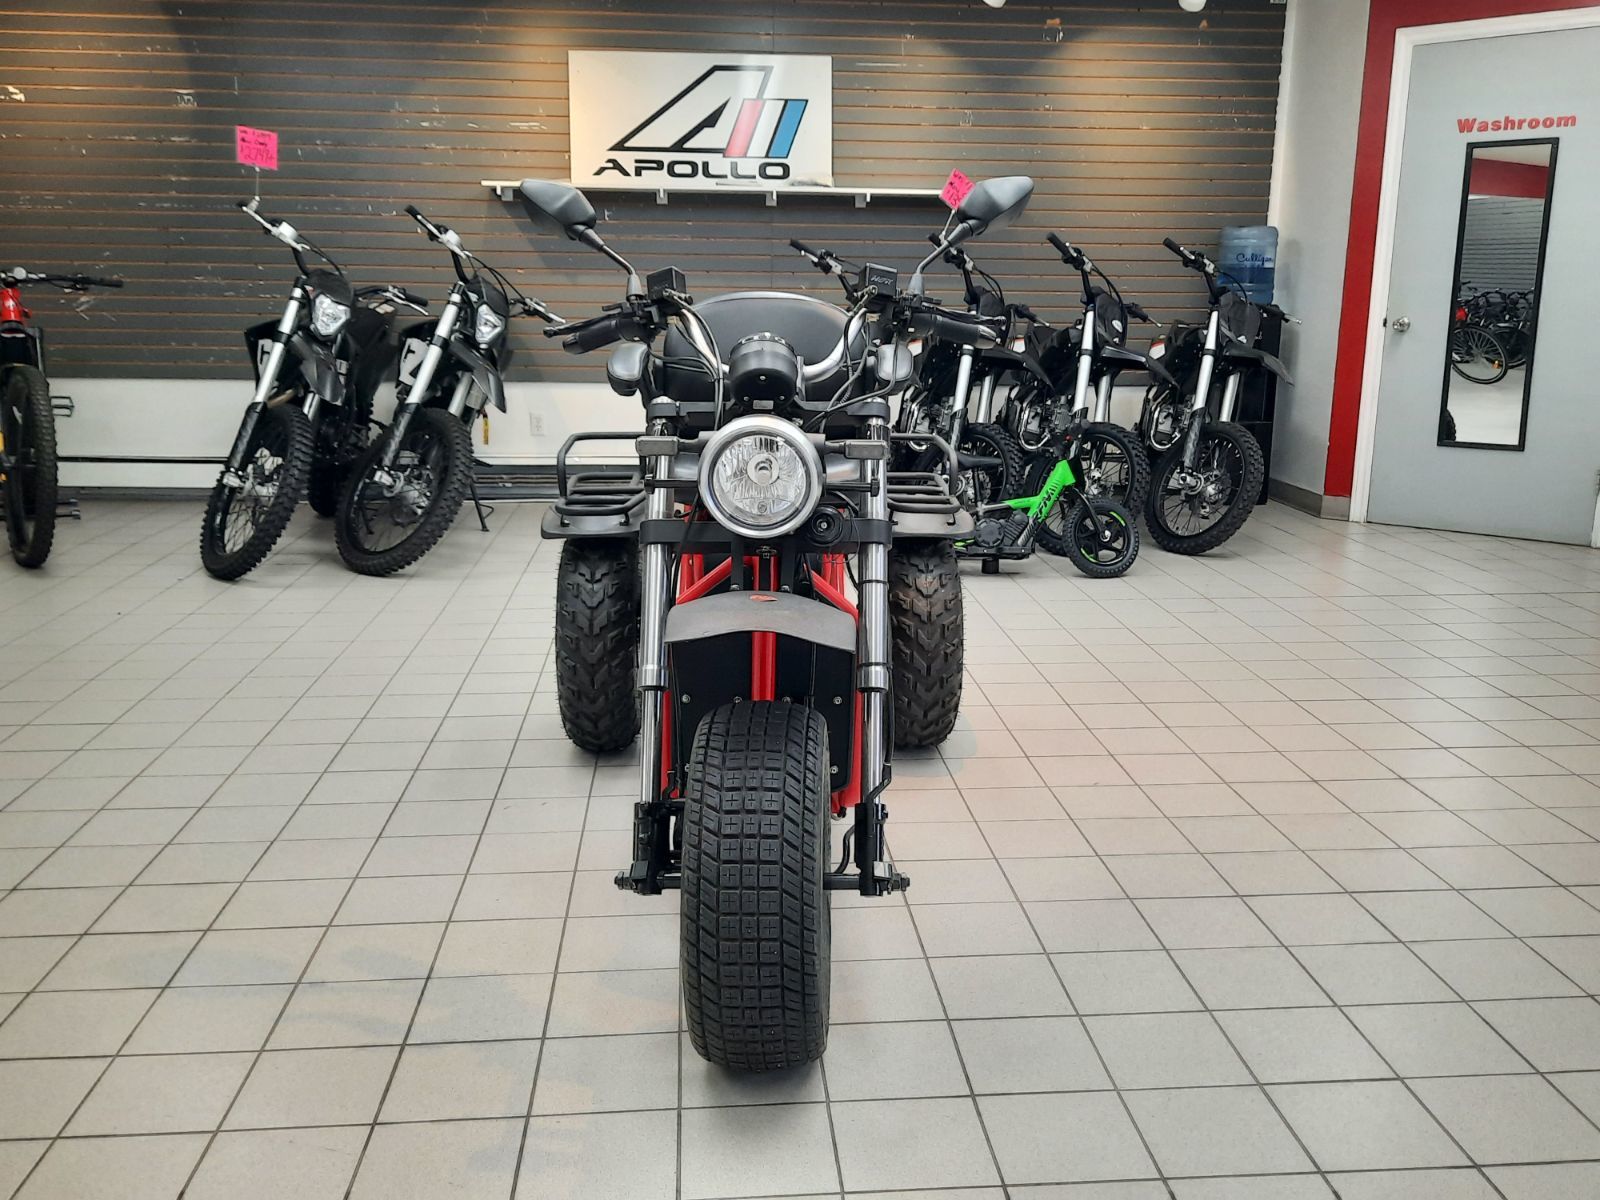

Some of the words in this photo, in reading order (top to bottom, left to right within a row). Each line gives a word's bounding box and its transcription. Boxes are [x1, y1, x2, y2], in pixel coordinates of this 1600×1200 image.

[1457, 115, 1577, 133] Washroom
[592, 158, 790, 180] APOLLO
[1235, 252, 1273, 266] Culligan
